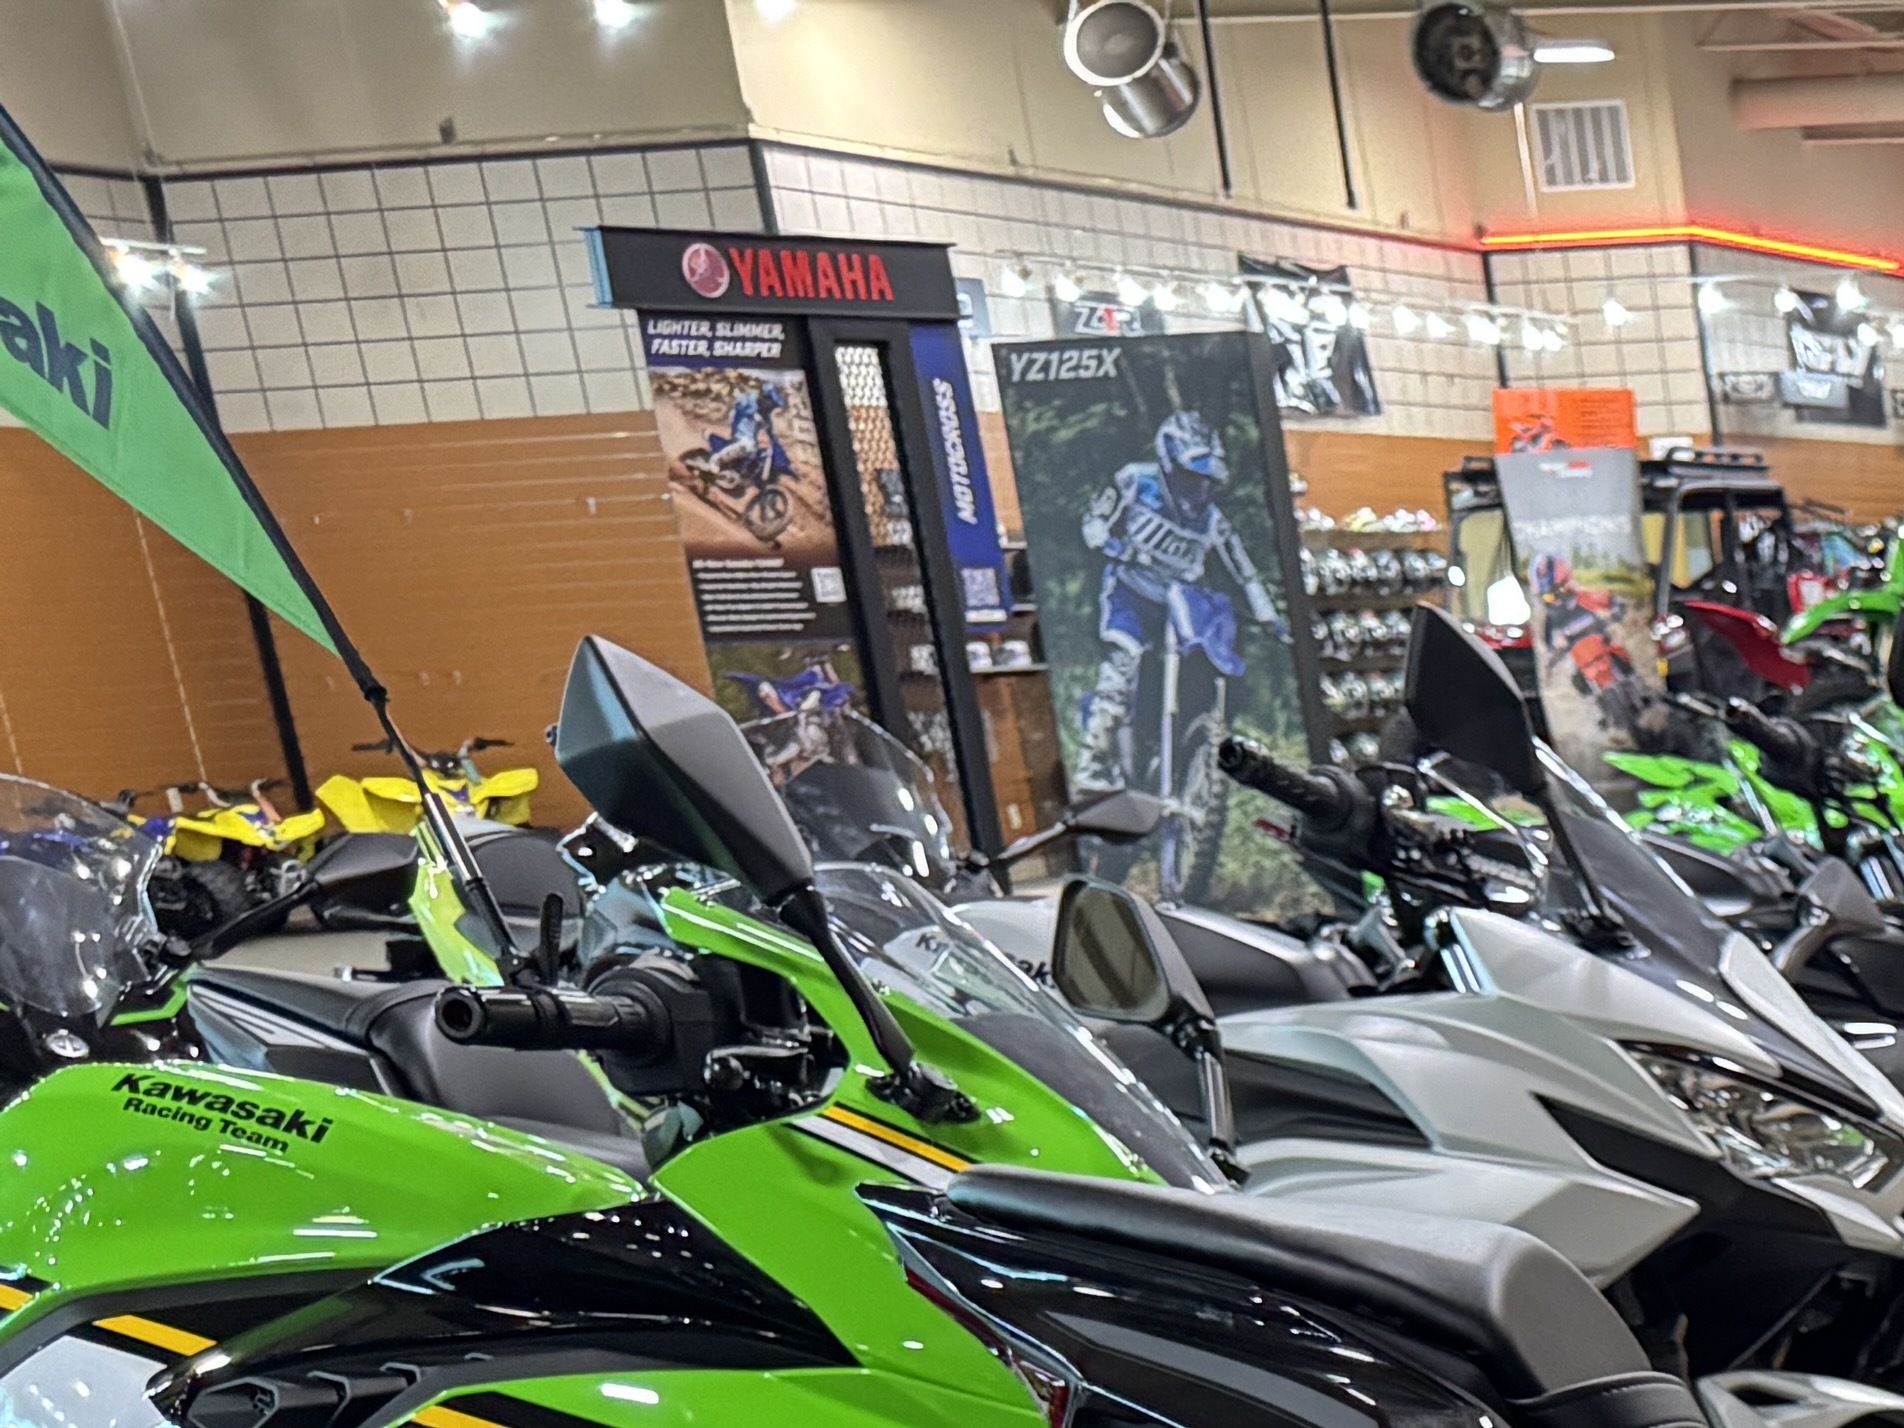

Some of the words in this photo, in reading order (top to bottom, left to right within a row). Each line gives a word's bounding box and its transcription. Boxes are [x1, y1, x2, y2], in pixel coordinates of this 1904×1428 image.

[728, 247, 895, 301] YAMAHA
[1010, 346, 1121, 383] YZ125X
[111, 1072, 334, 1144] Kawasaki
[123, 1096, 213, 1131] Racing
[218, 1117, 290, 1154] Team
